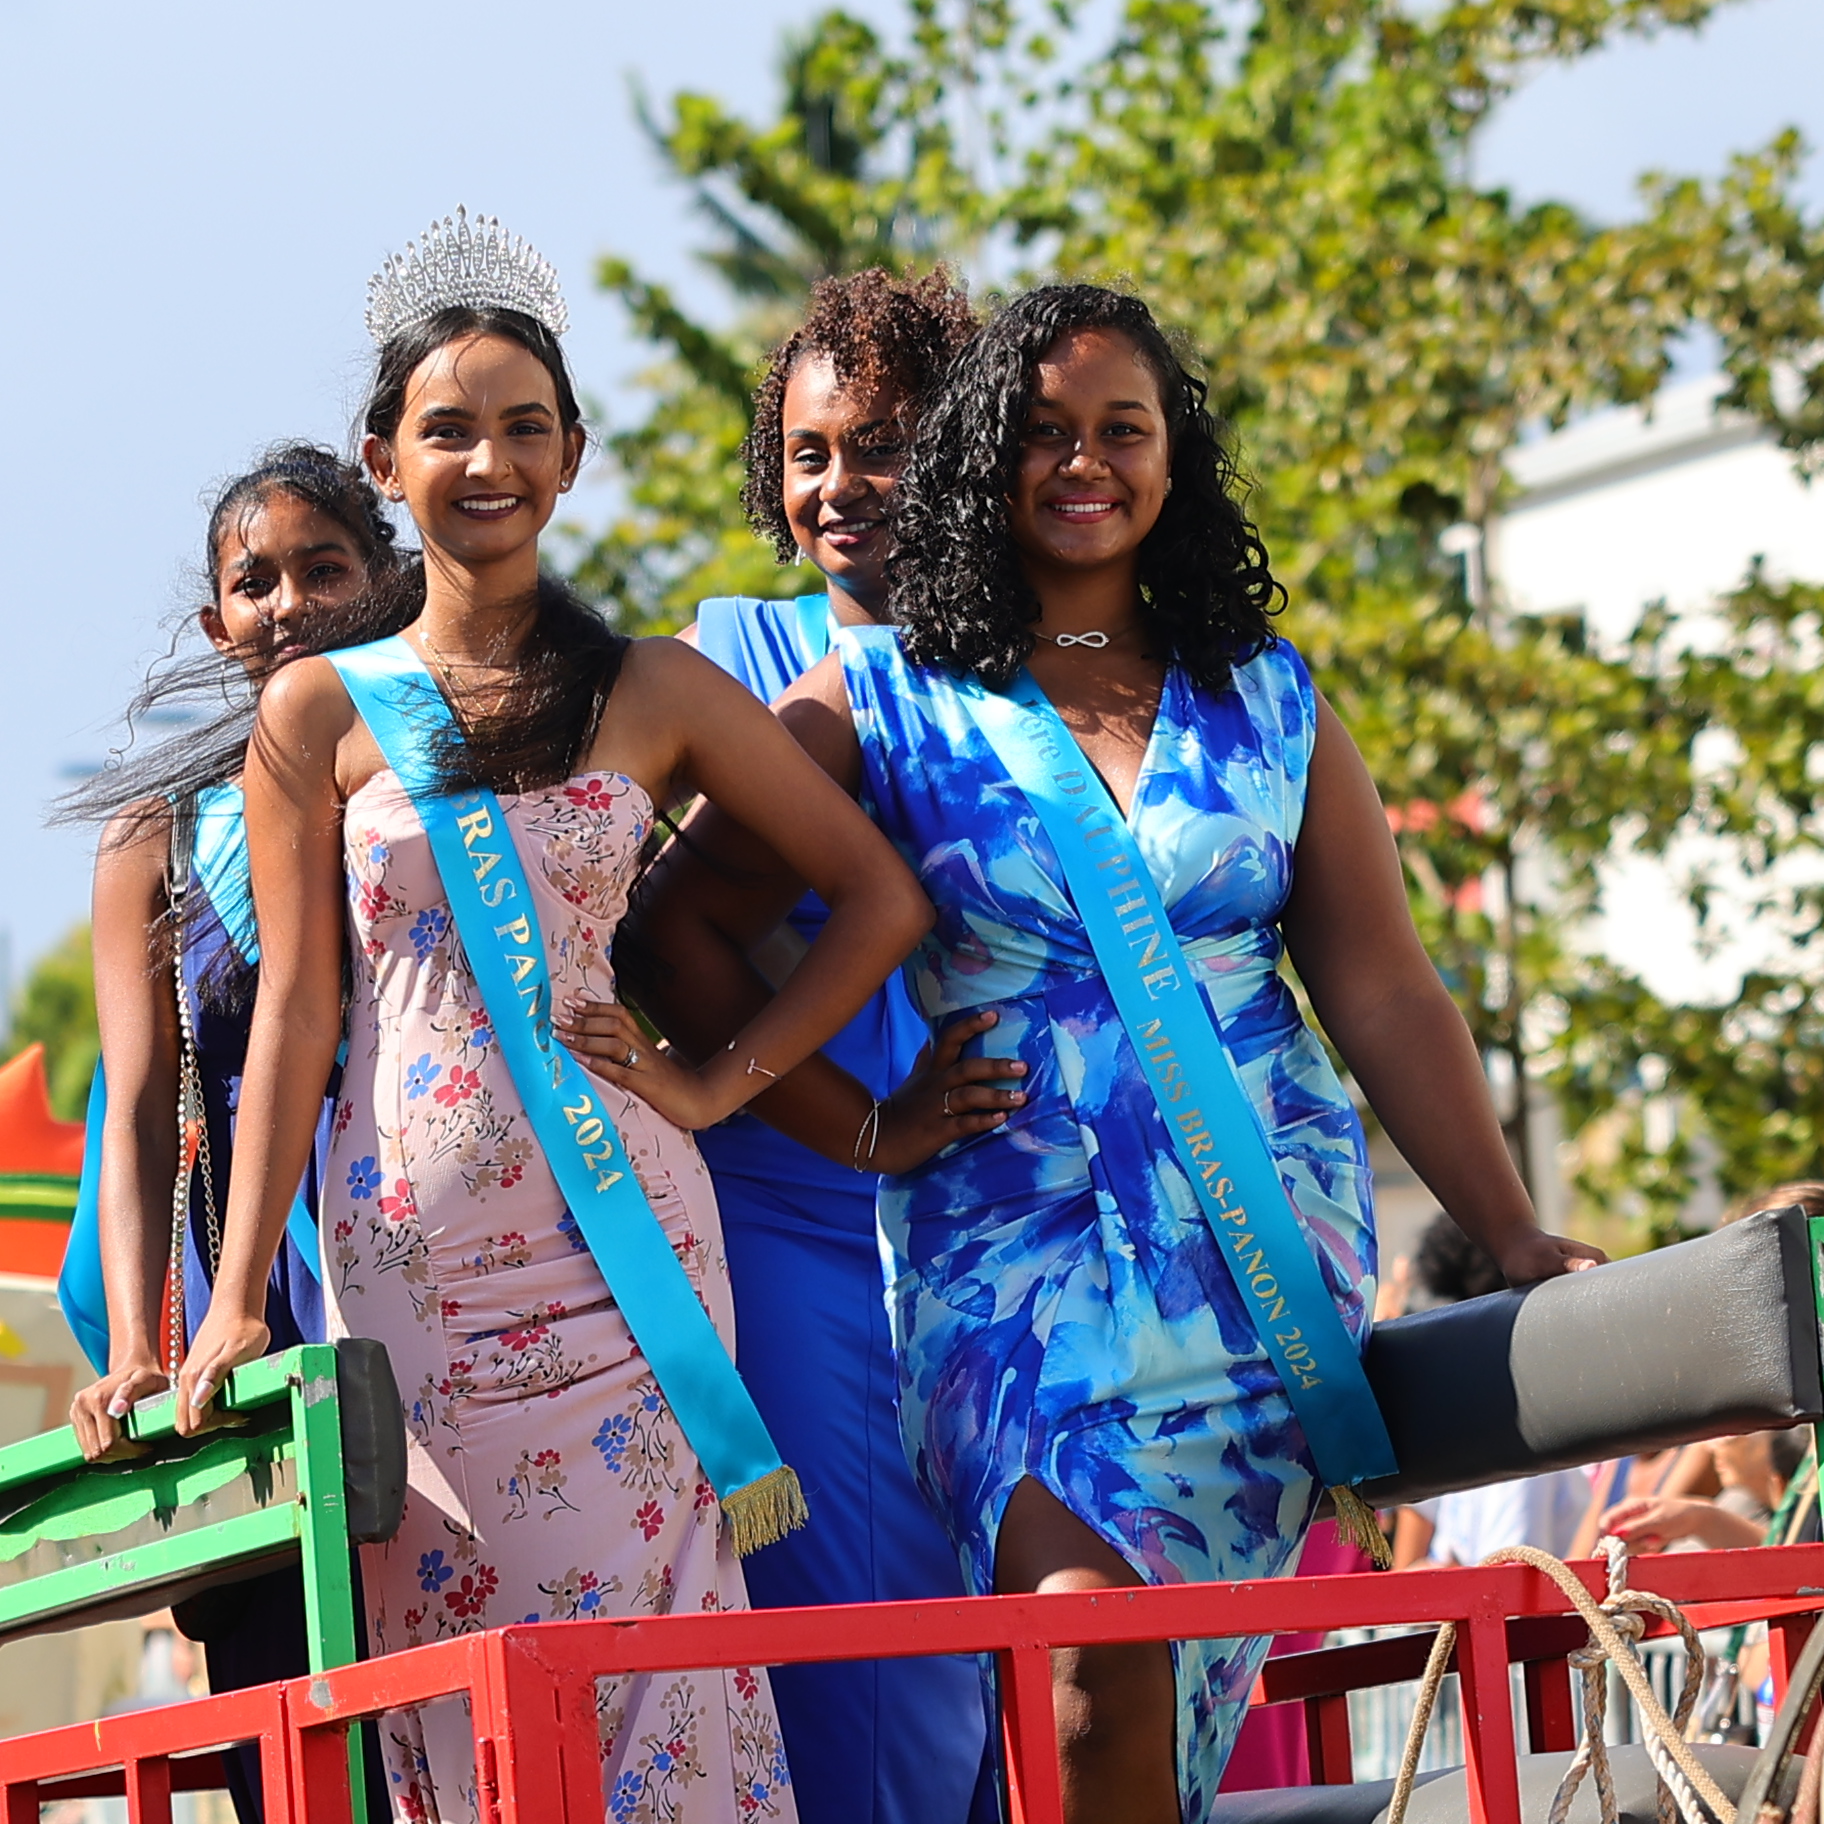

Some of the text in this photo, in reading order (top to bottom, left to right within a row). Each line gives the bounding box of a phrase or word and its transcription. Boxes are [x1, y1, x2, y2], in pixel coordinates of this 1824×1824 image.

[450, 786, 517, 908] BRAS
[493, 912, 574, 1091] PANON
[563, 1094, 624, 1194] 2024
[1052, 768, 1182, 1001] DAUPHINE
[1136, 1017, 1192, 1103] MISS
[1176, 1108, 1291, 1323] BRAS-PANON
[1275, 1326, 1323, 1392] 2024
